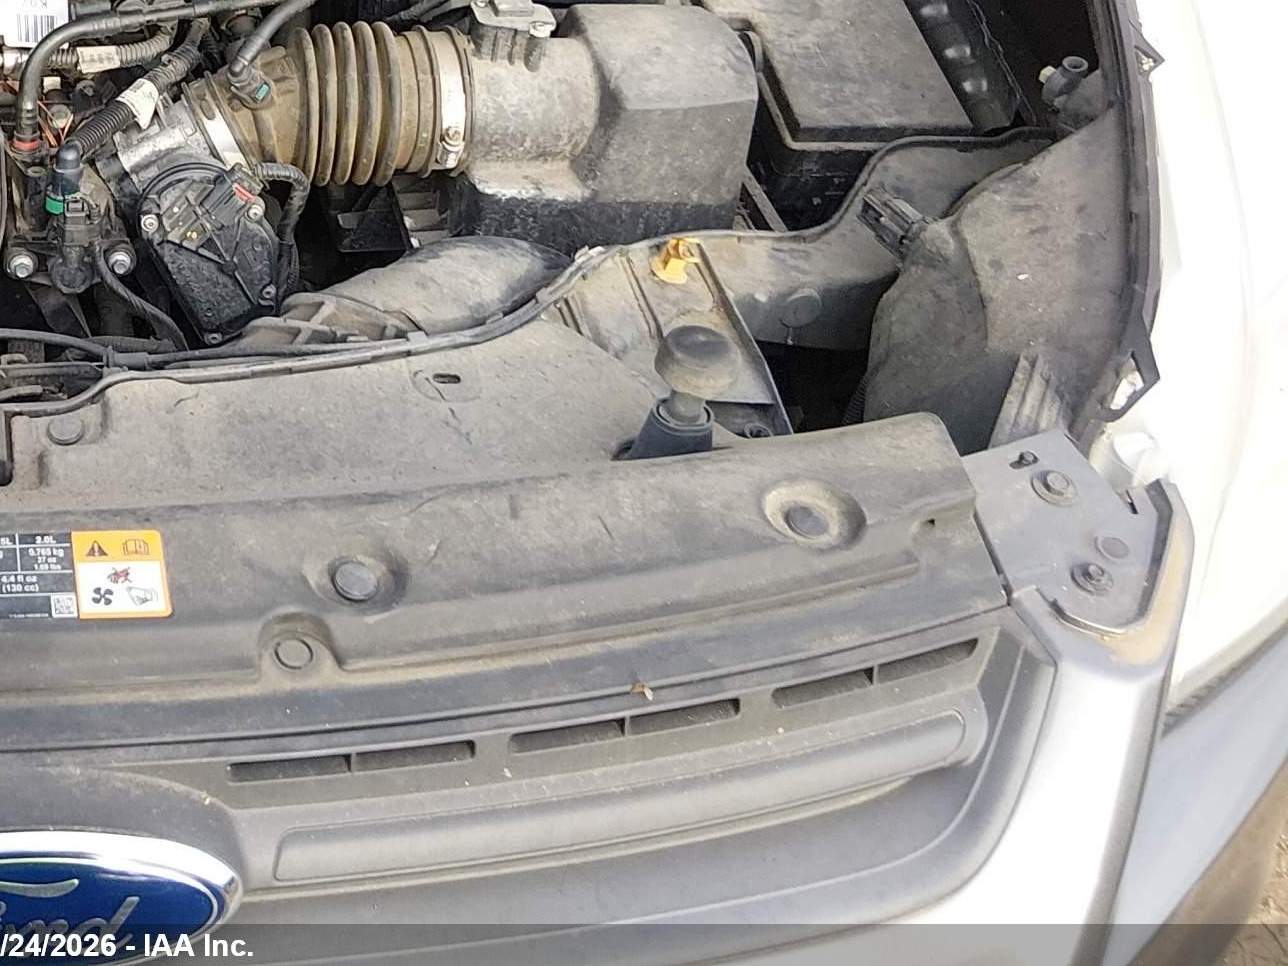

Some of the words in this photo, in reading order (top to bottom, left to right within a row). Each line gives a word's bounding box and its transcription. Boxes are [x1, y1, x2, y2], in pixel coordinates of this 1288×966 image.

[35, 535, 56, 544] 2.0L
[52, 548, 64, 558] kg
[24, 583, 39, 592] cc)
